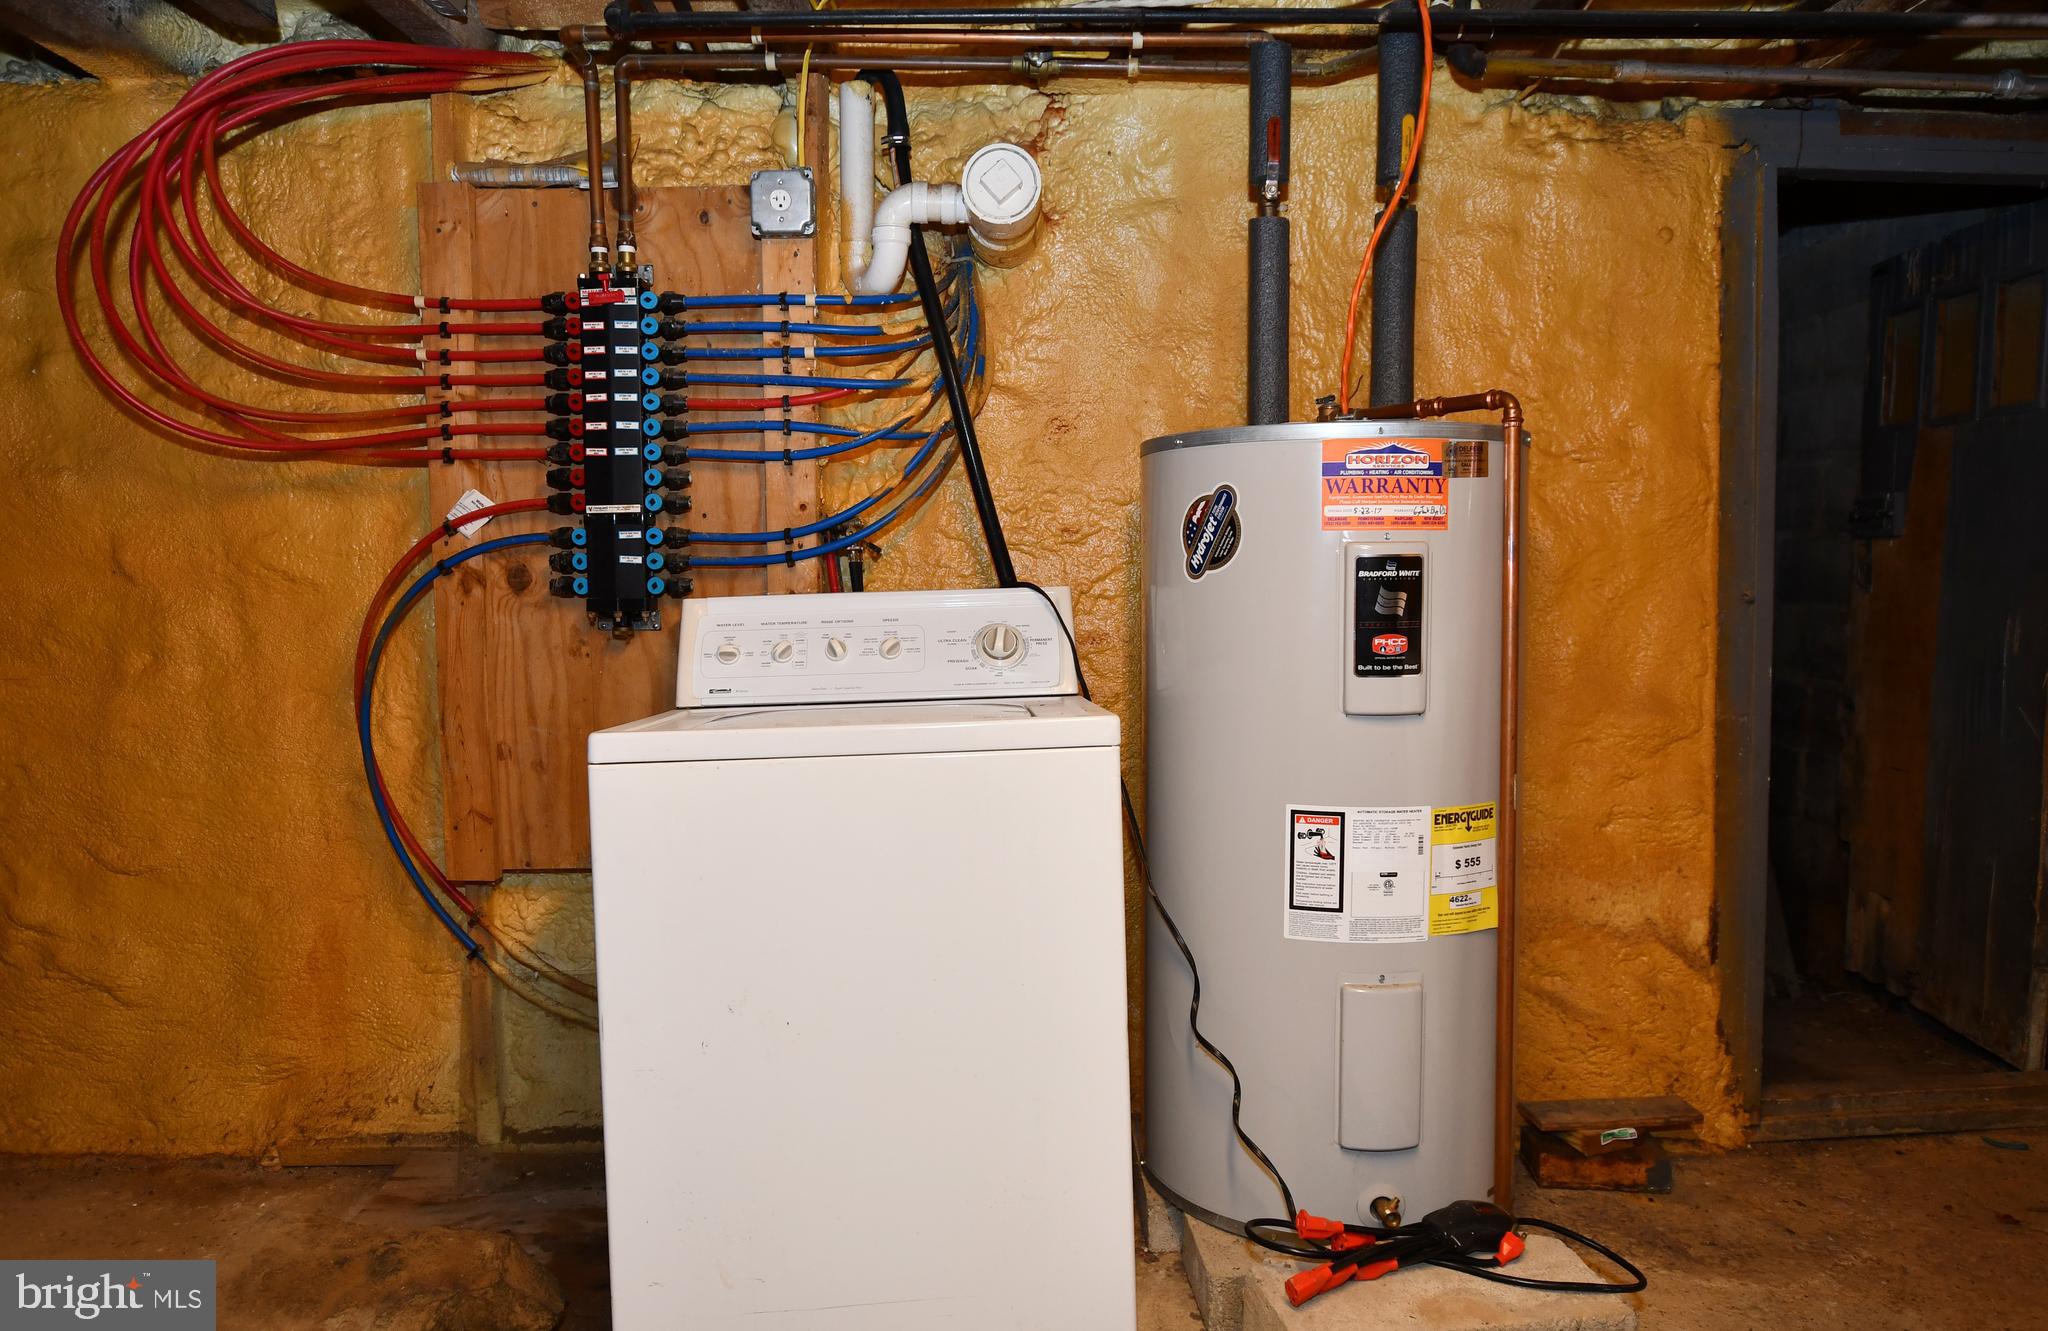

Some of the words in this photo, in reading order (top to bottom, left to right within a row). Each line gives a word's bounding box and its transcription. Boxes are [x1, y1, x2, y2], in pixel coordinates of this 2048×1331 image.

[1348, 455, 1428, 465] HORIZON
[1326, 478, 1446, 494] WARRANTY
[1190, 517, 1218, 569] Hydrojet
[1434, 807, 1494, 826] ENERGYGUIDE
[1455, 860, 1461, 869] $
[1464, 857, 1481, 868] 555
